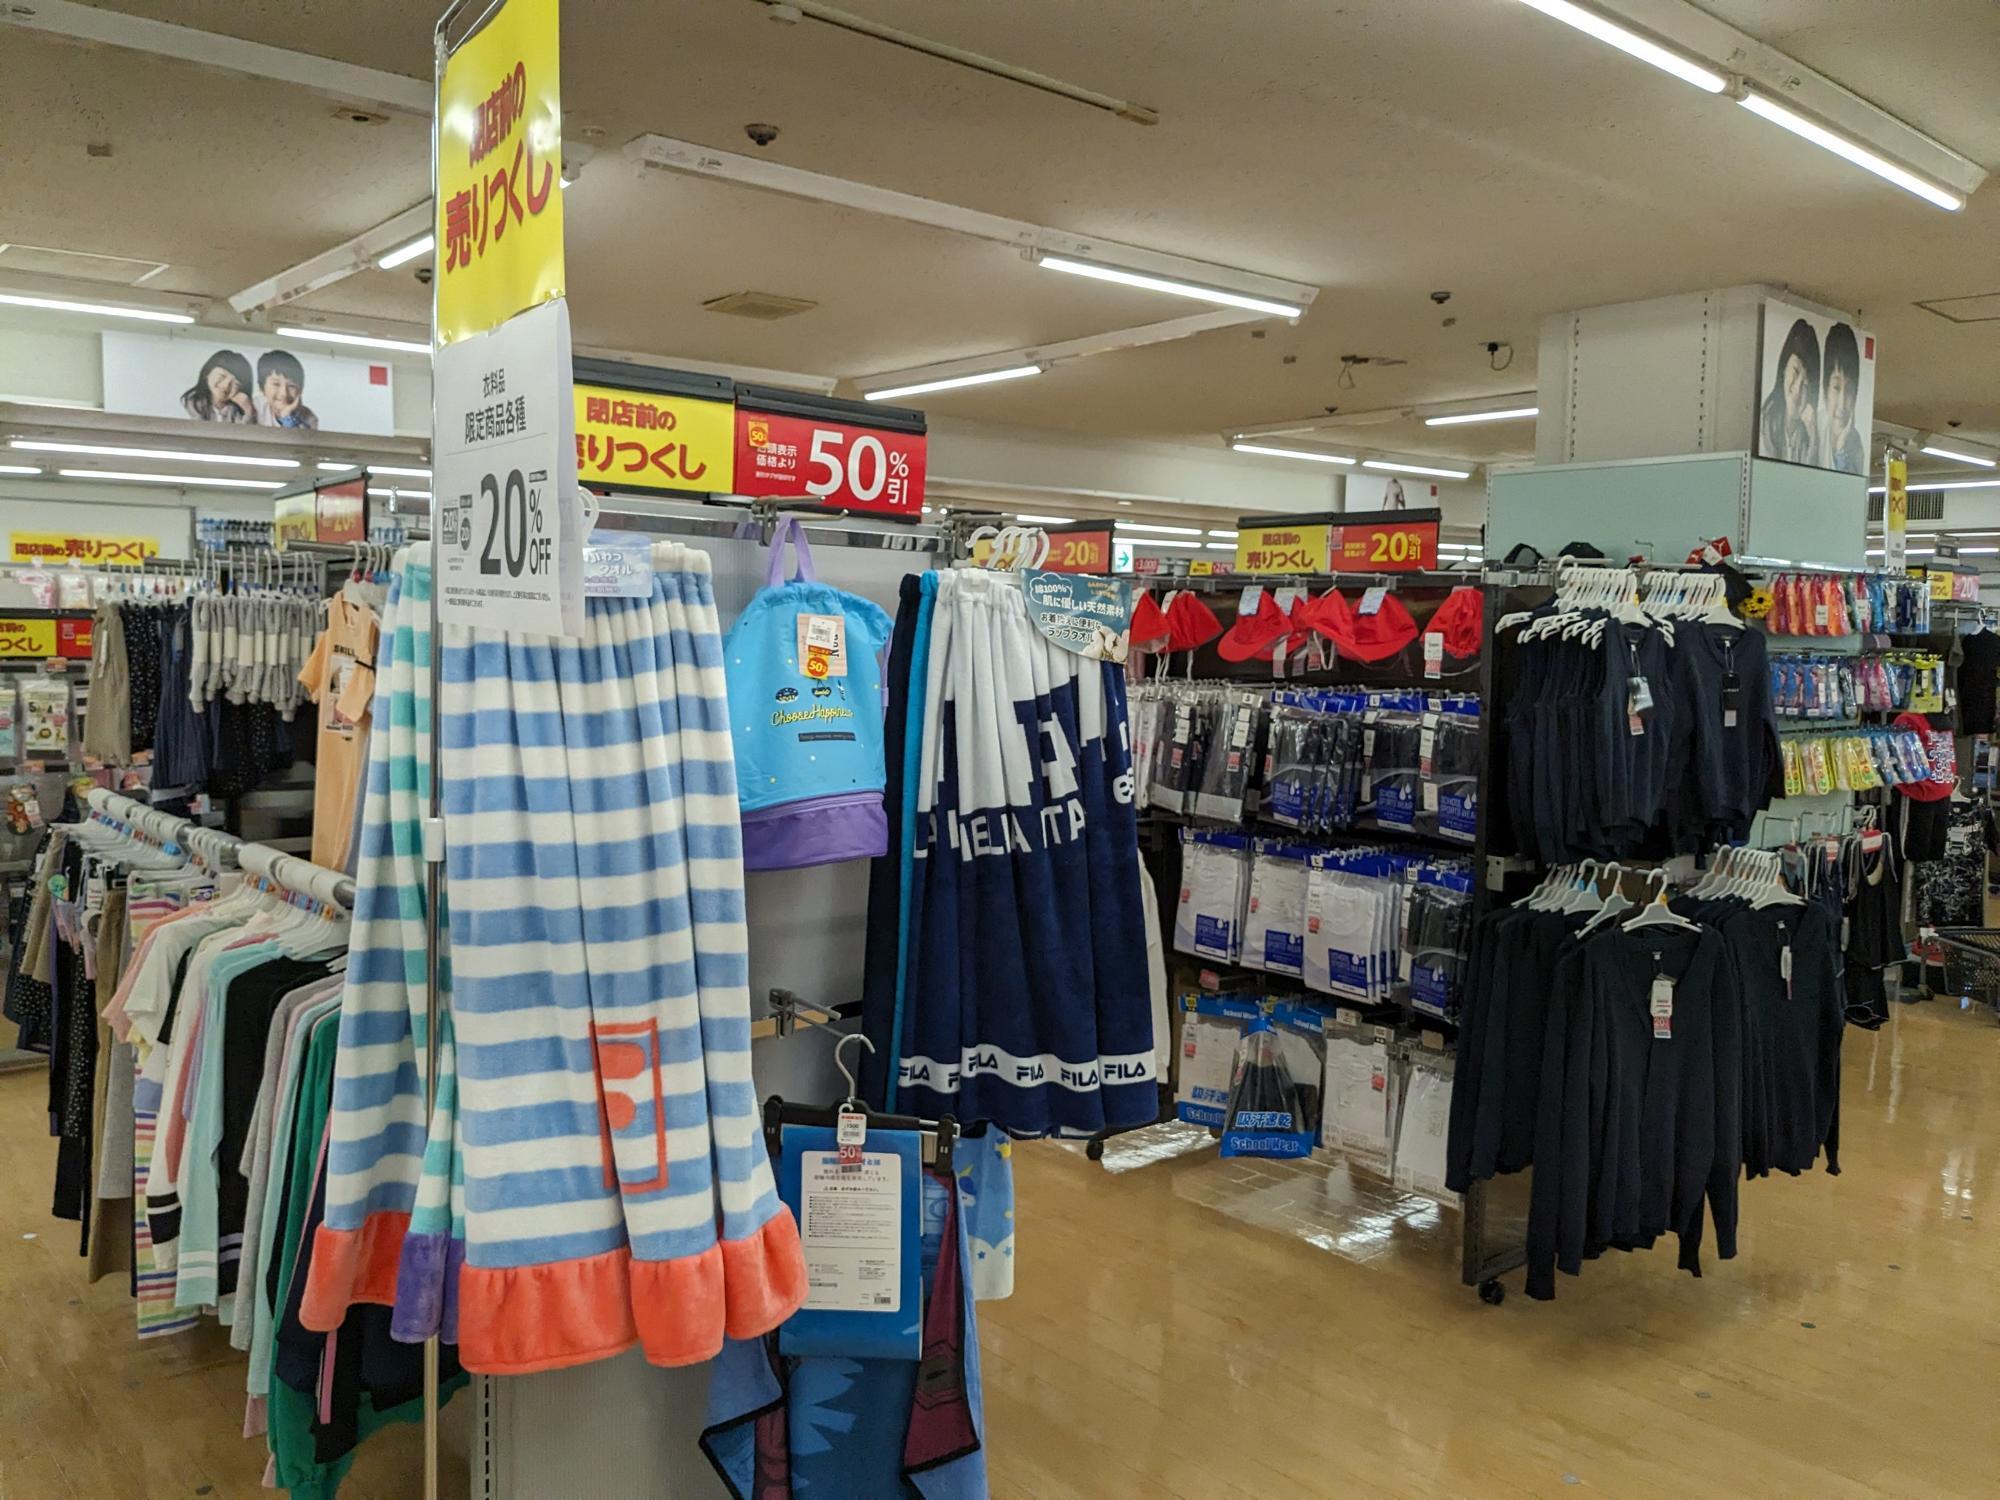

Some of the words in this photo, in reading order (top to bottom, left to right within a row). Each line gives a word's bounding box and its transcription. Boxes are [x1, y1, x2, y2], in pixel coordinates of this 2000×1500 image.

[446, 138, 553, 274] 売りつくし
[482, 367, 506, 398] 衣料品
[465, 395, 527, 445] 限定商品各種
[586, 396, 677, 431] 閉店前の
[529, 537, 552, 575] OFF
[1246, 549, 1315, 570] 売りつくし
[900, 1064, 930, 1081] FILA
[1016, 1066, 1044, 1082] FILA
[1061, 1067, 1099, 1087] FILA
[1103, 1061, 1147, 1079] FILA
[1230, 1136, 1270, 1150] School
[1270, 1137, 1299, 1152] Wear
